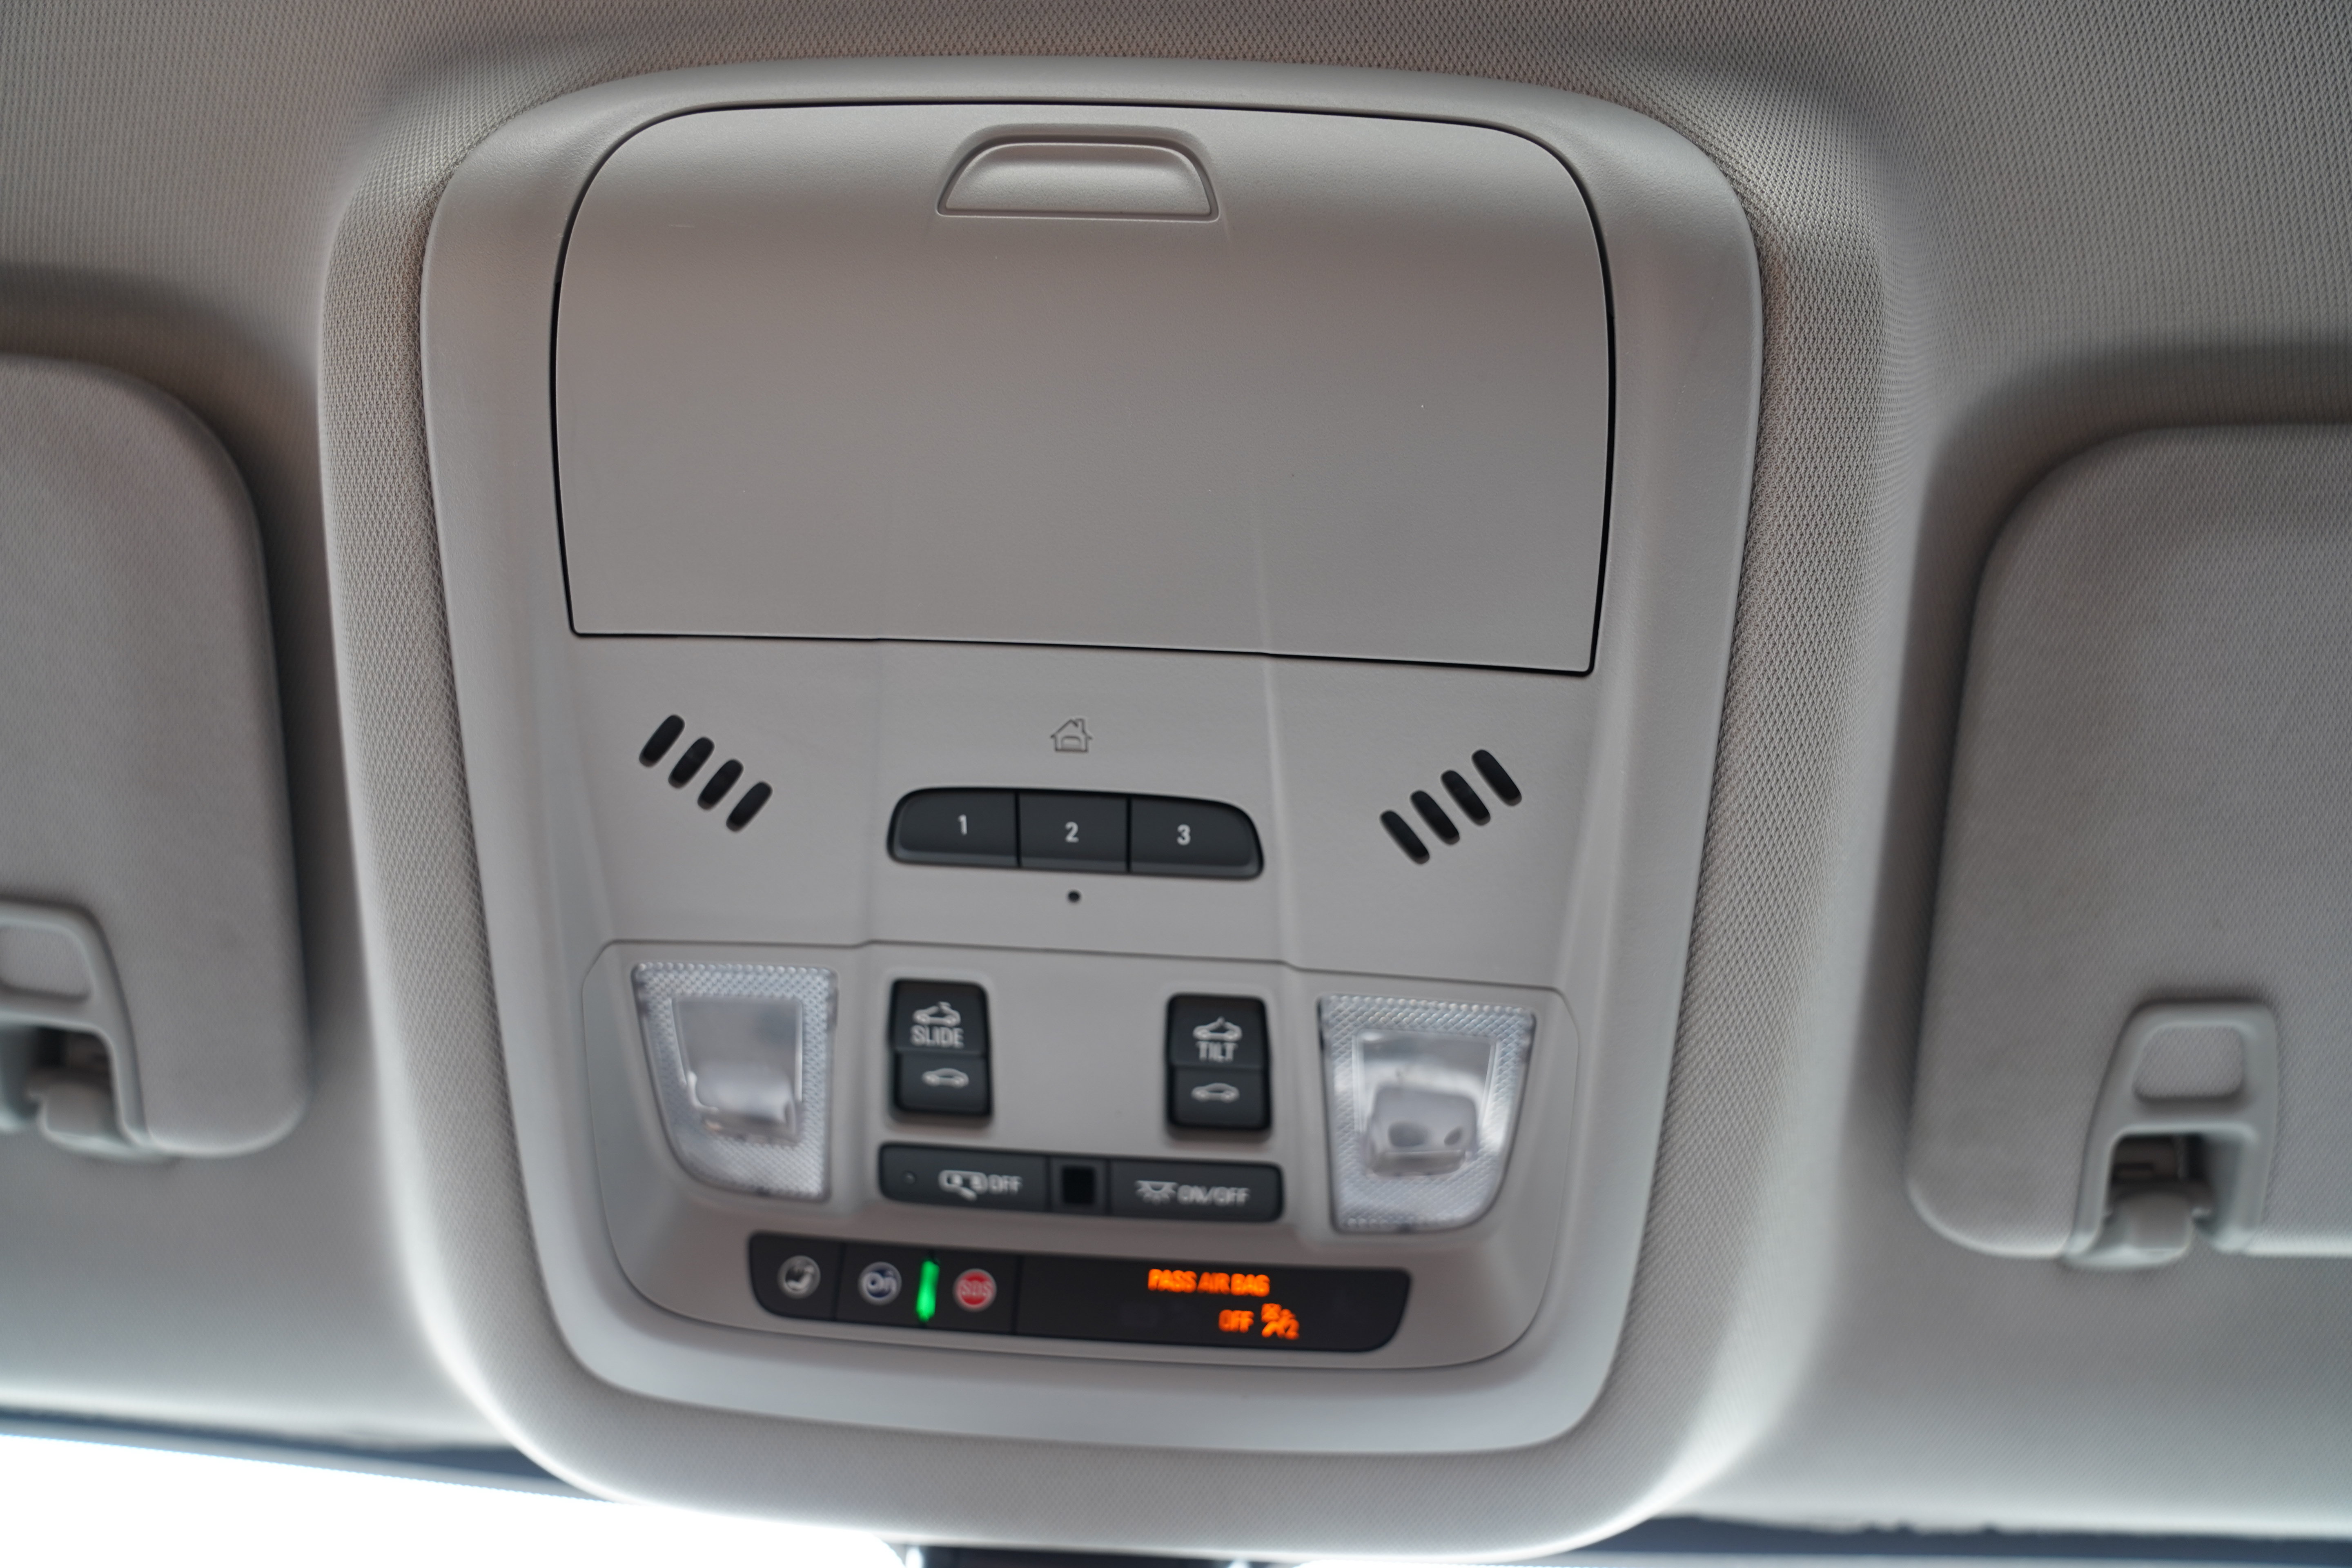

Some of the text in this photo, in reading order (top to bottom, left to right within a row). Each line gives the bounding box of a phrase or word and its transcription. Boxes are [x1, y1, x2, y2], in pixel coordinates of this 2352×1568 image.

[958, 815, 1190, 845] 1 2 3
[911, 1025, 964, 1048] SLIDE
[1196, 1041, 1238, 1062] TILT
[988, 1174, 1022, 1194] OFF
[1178, 1185, 1250, 1205] ON/OFF
[958, 1279, 993, 1297] SOS
[1148, 1269, 1270, 1297] PASS AIR BAG
[1218, 1309, 1254, 1333] OFF
